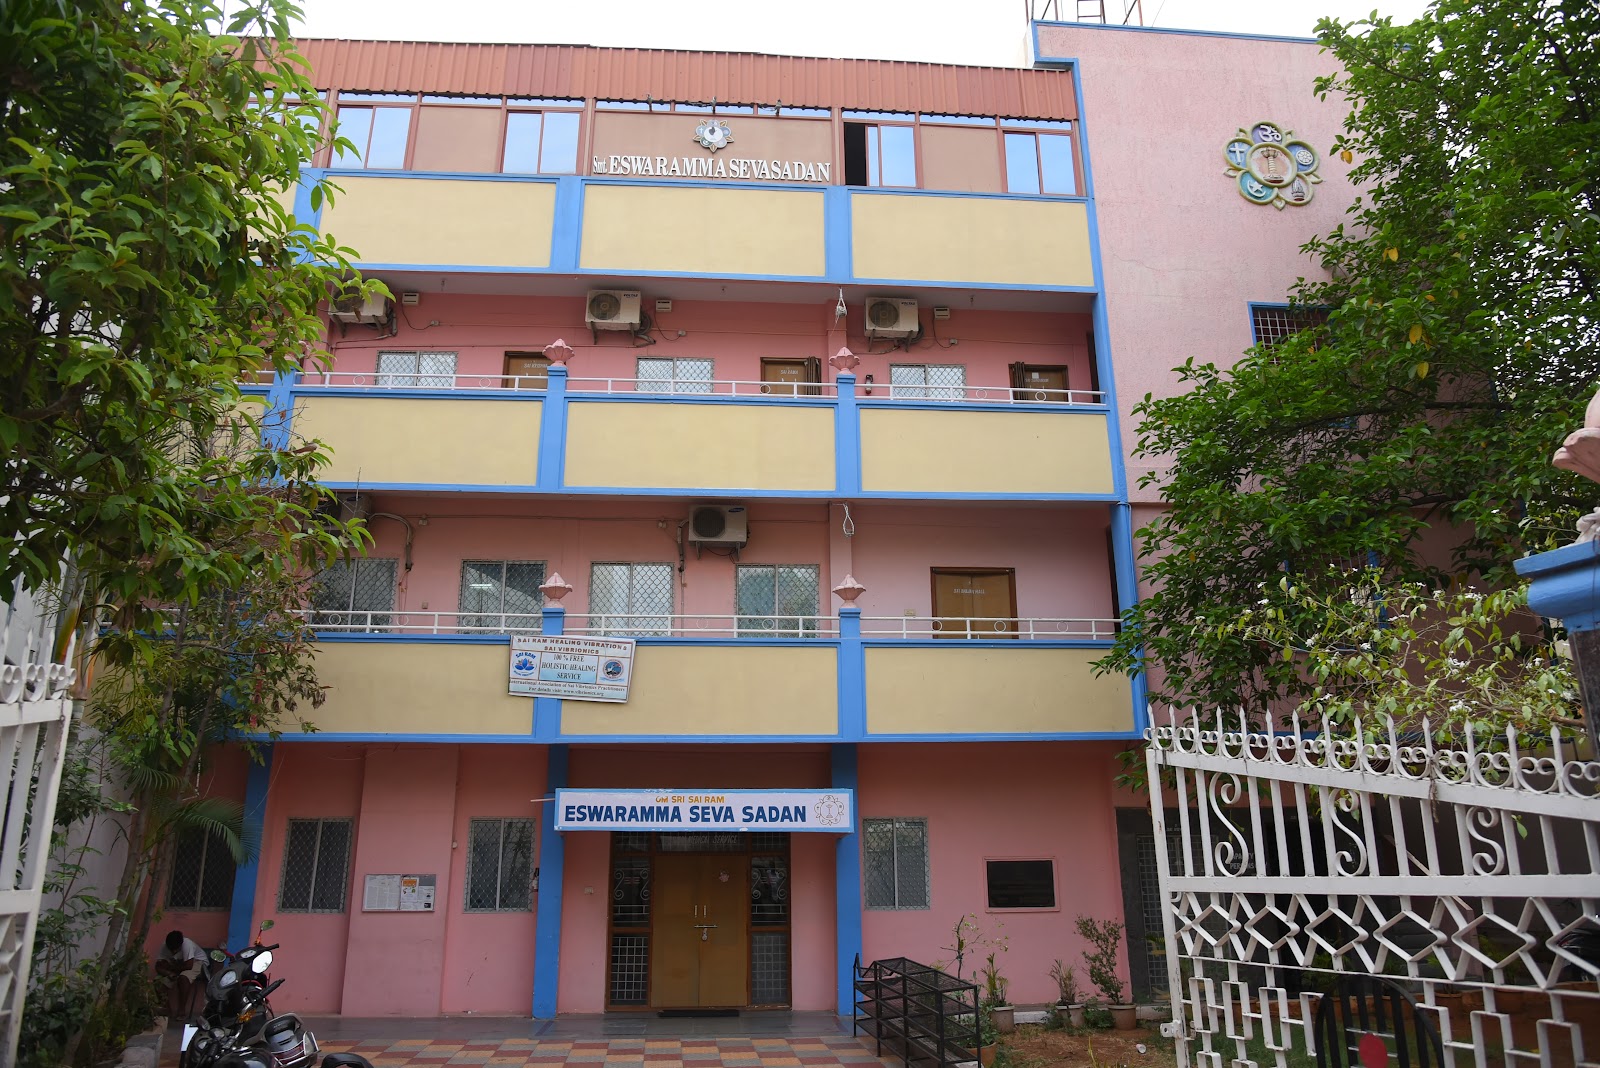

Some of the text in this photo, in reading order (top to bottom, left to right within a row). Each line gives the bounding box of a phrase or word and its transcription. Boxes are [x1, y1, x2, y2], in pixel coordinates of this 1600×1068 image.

[608, 155, 728, 178] ESWARAMMA
[729, 158, 831, 182] SEVASADAN
[584, 641, 627, 650] VIBRATIONS
[541, 662, 569, 670] HOLISTIC
[569, 664, 596, 672] HEALING
[564, 805, 806, 822] ESWARAMMA SEVA SADAN
[713, 835, 738, 844] SERVICE
